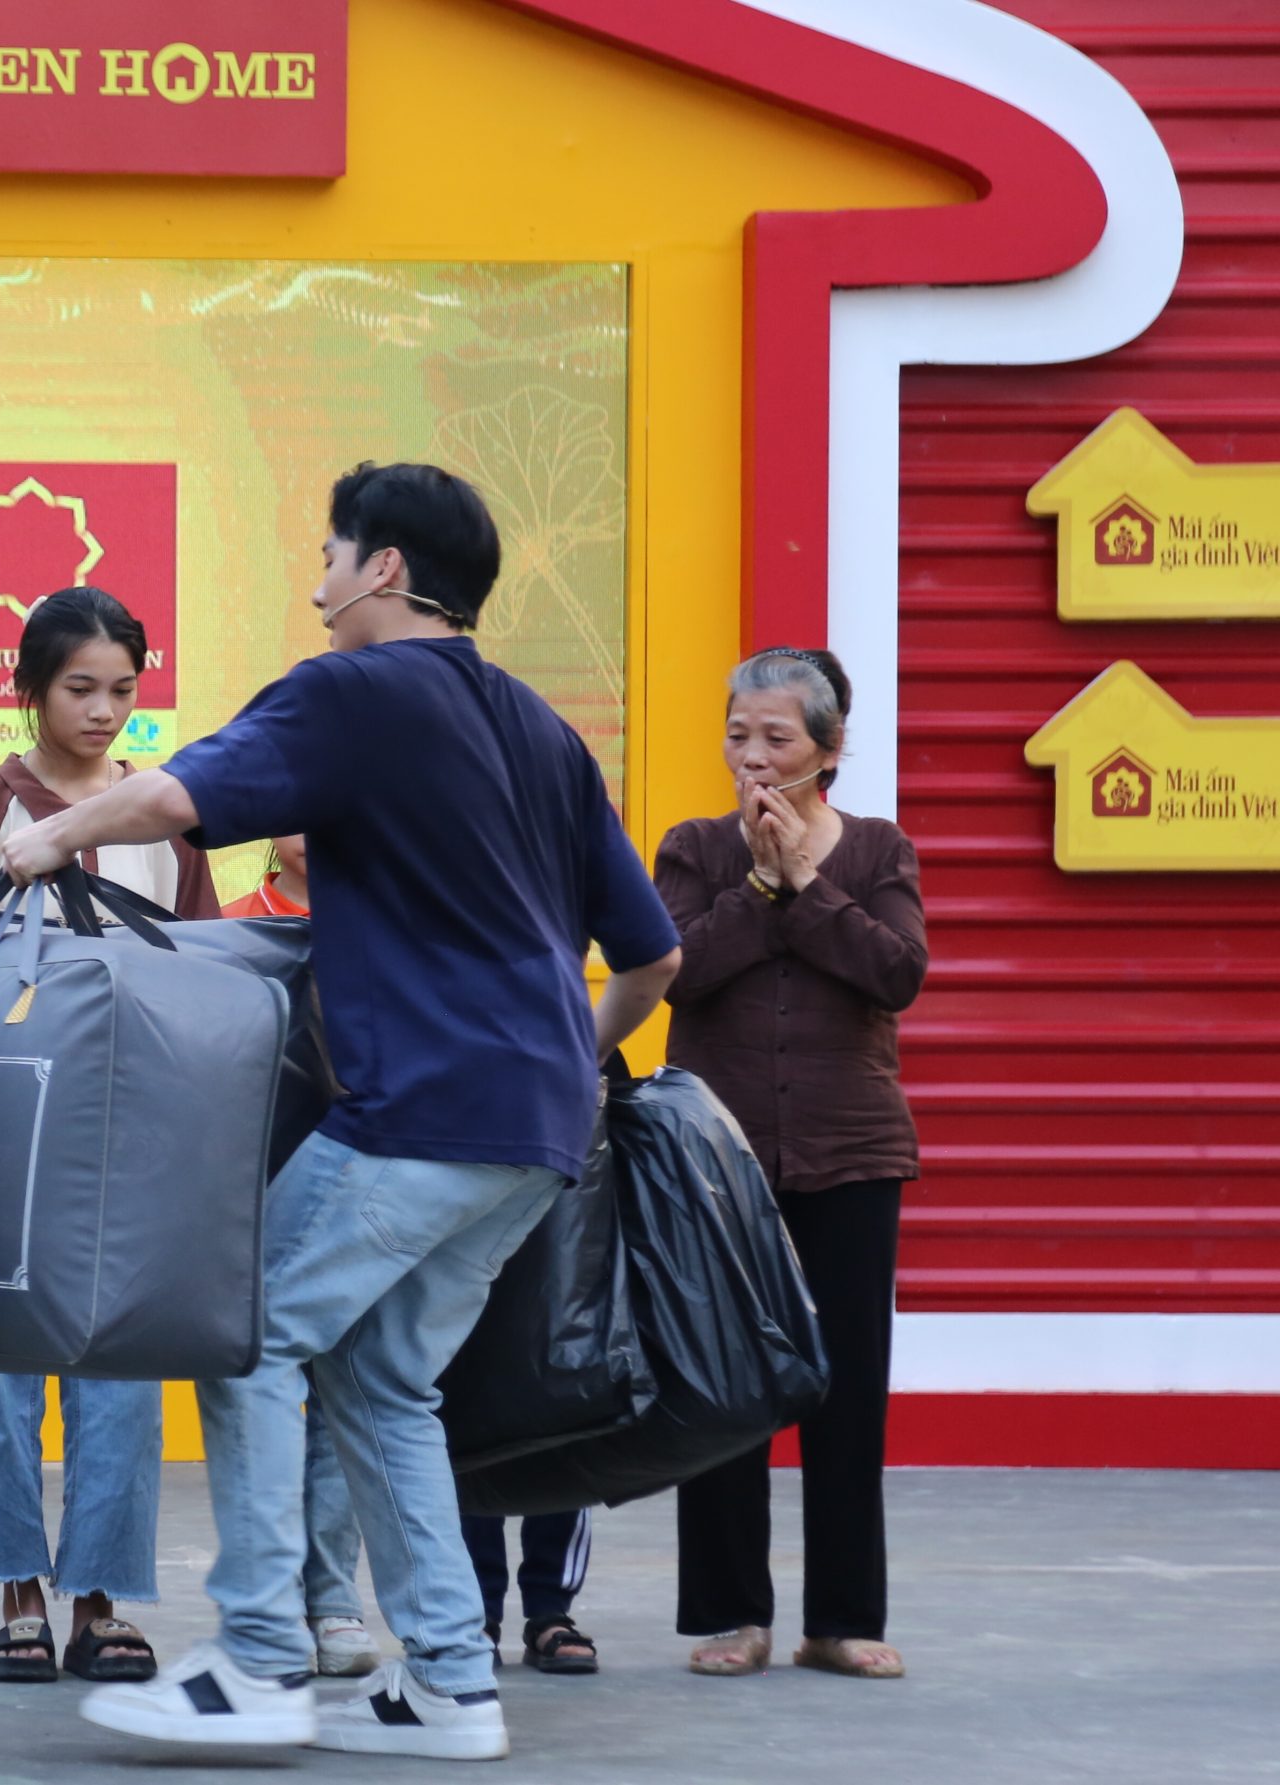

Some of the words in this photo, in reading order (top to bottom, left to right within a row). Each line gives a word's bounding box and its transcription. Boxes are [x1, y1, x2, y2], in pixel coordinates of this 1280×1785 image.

[99, 42, 316, 104] HOME
[1160, 544, 1189, 576] gia
[1157, 797, 1186, 827] gia
[1242, 793, 1278, 824] Việt
